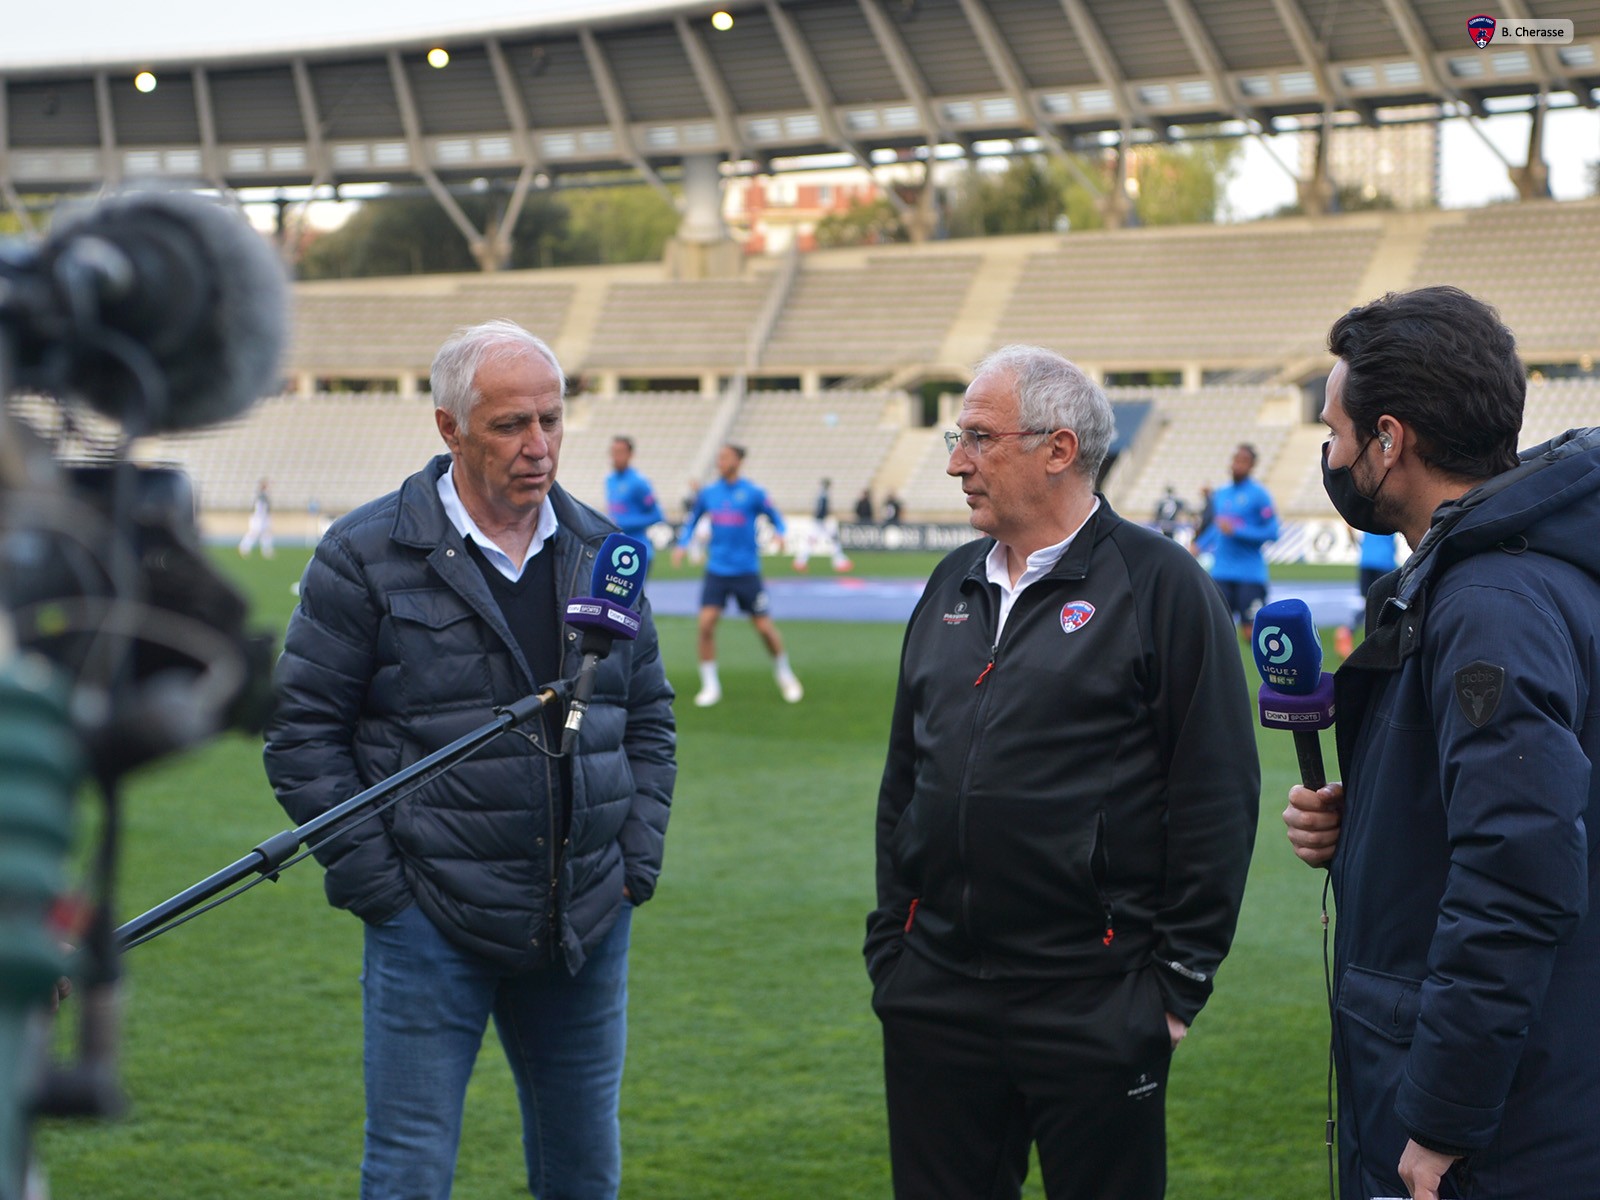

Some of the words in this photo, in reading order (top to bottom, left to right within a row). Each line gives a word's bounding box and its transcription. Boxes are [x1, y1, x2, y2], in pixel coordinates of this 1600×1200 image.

[605, 574, 629, 588] LIGUE
[628, 582, 634, 590] 2
[1262, 664, 1289, 676] LIGUE
[1462, 670, 1495, 683] nobis
